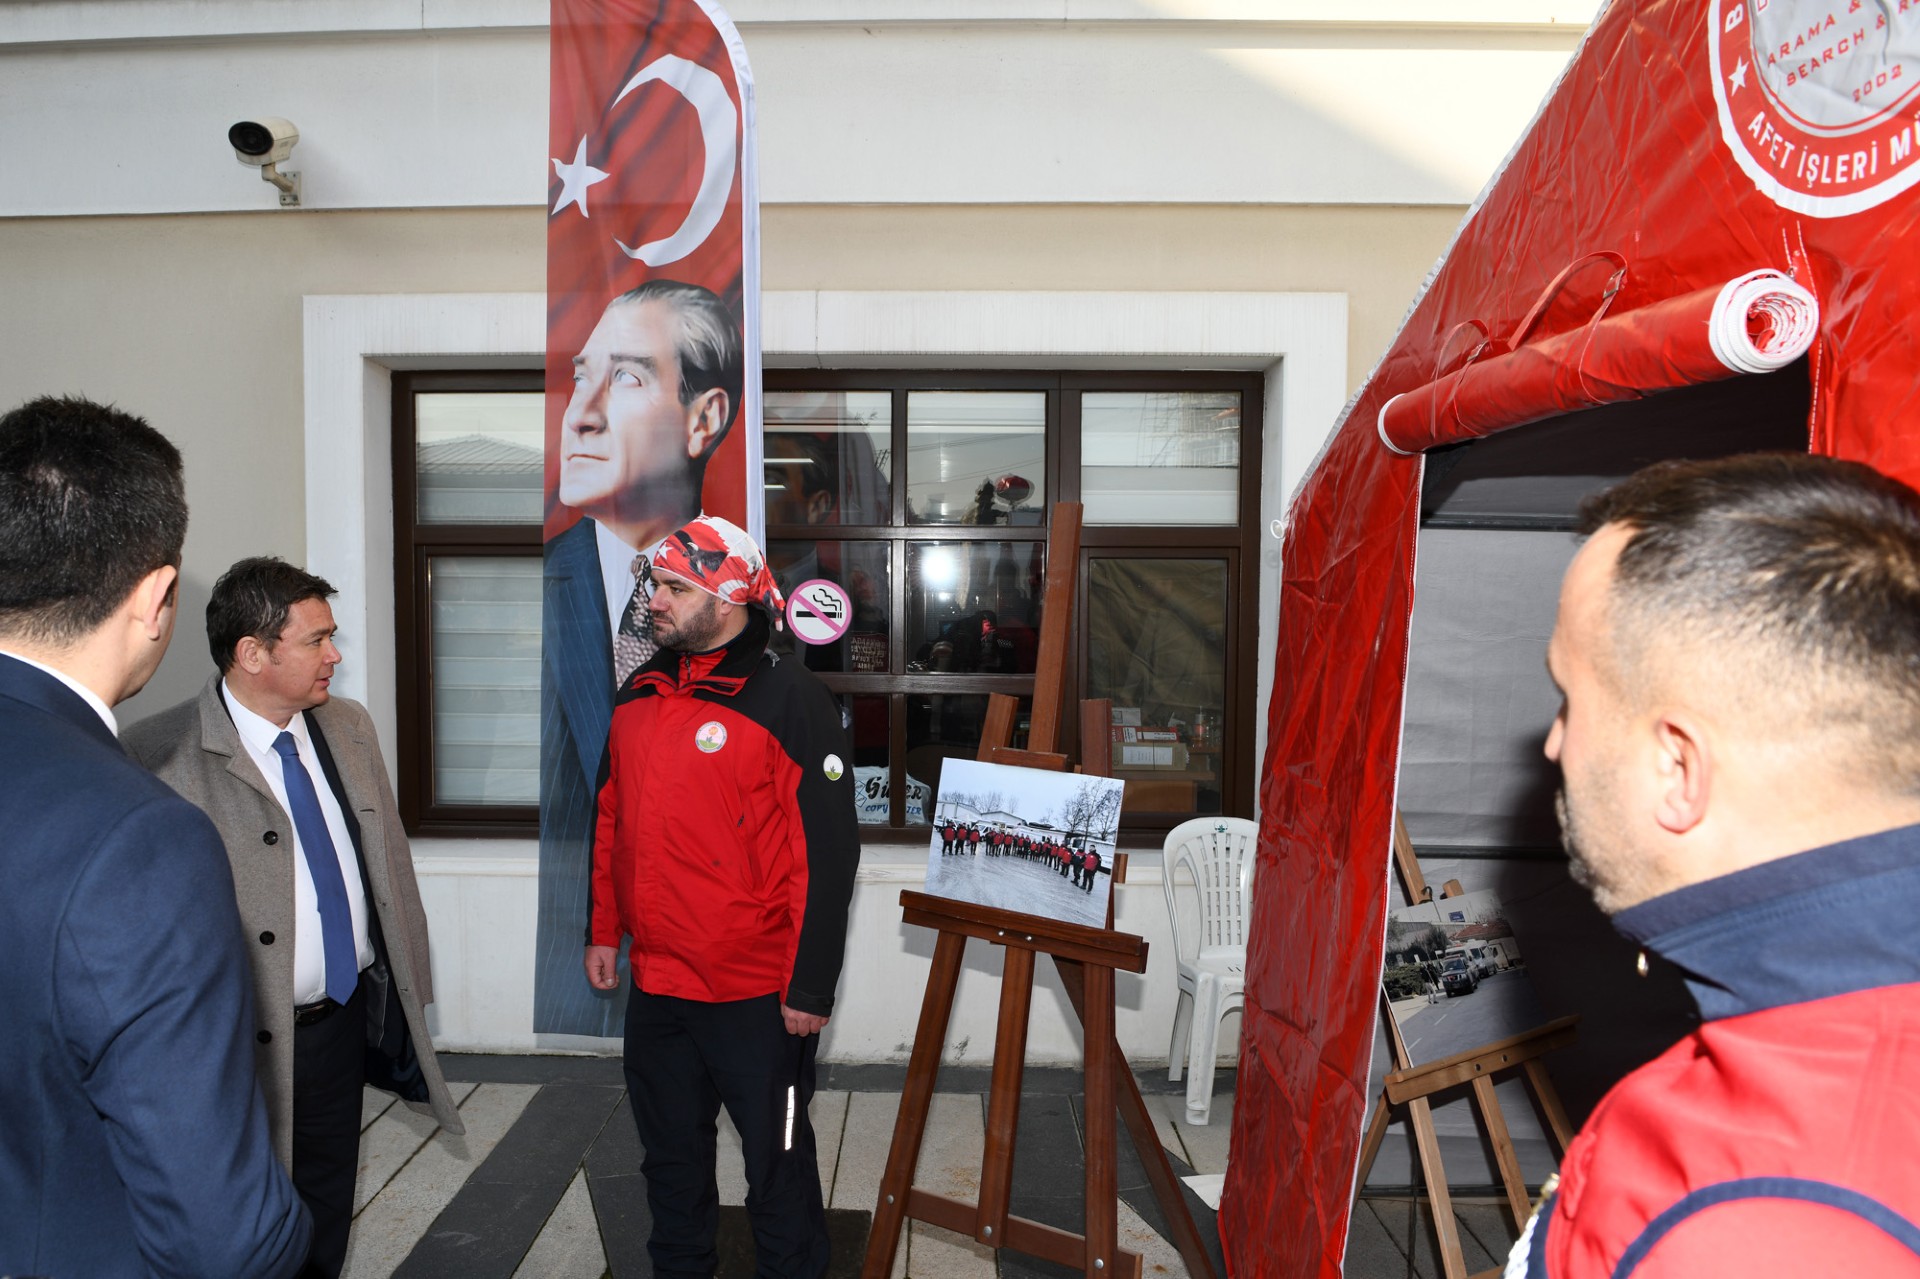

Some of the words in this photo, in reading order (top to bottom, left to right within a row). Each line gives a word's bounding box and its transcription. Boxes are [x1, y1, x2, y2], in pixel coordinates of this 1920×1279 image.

[1767, 13, 1836, 68] ARAMA
[1786, 27, 1865, 87] SEARCH
[1876, 13, 1886, 30] &
[1852, 64, 1902, 103] 2002
[1747, 111, 1795, 169] AFET
[1797, 140, 1878, 188] İŞLERİ
[865, 804, 888, 814] COPY
